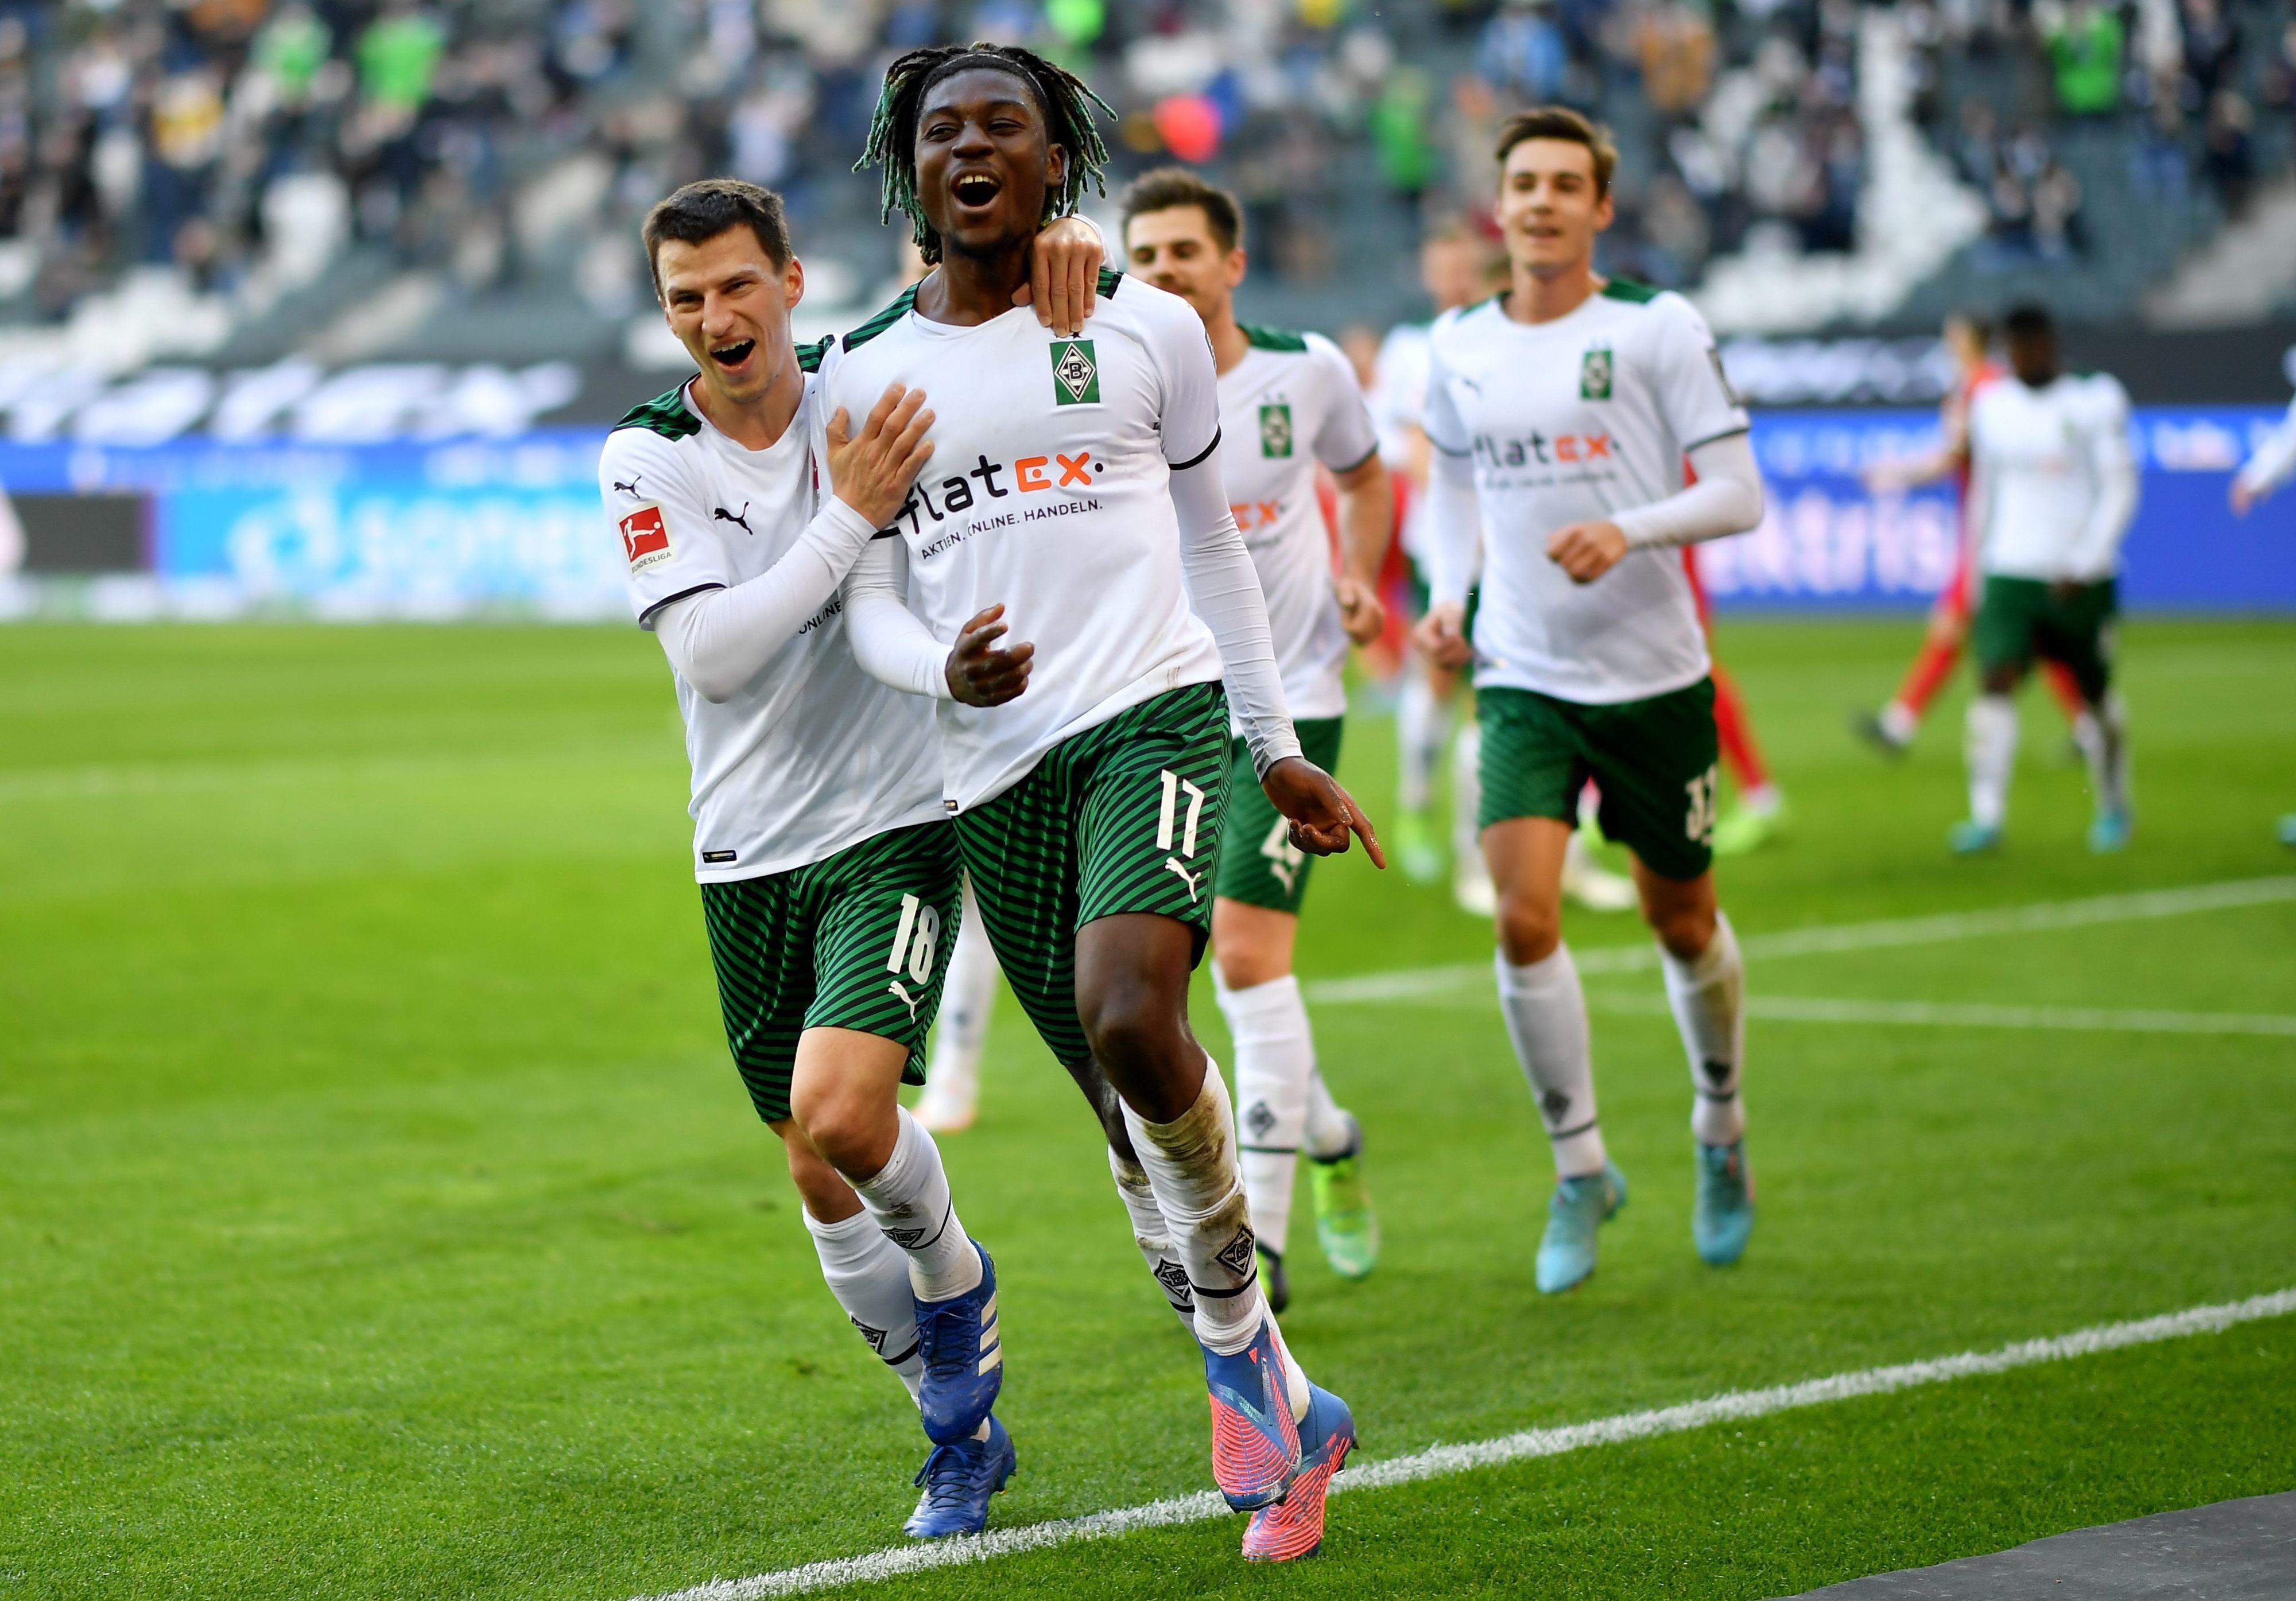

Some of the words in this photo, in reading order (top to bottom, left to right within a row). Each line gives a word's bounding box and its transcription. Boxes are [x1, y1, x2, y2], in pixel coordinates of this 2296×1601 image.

[1025, 498, 1103, 523] HANDELN.
[1156, 769, 1205, 859] 17
[886, 893, 940, 985] 18
